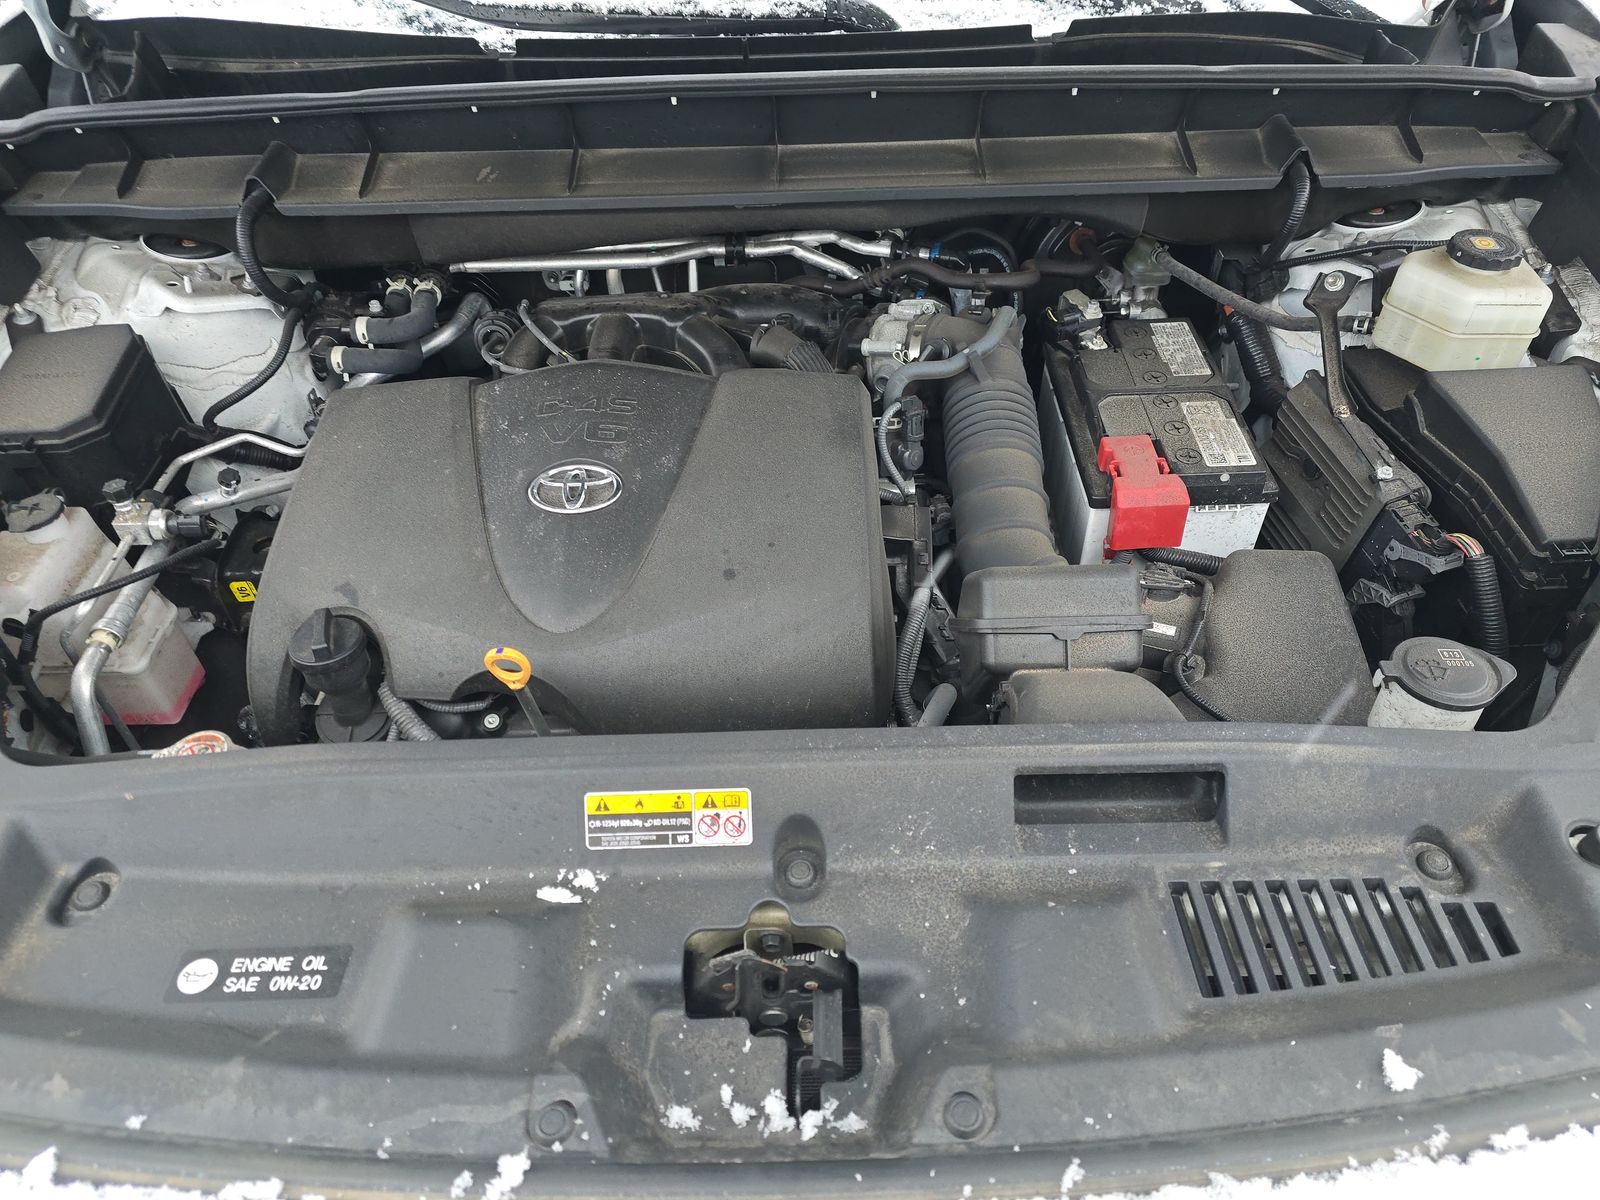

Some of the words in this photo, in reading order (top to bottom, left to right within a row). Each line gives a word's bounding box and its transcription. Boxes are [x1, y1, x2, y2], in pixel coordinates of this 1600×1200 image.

[539, 421, 630, 444] V6
[236, 586, 250, 597] V6
[676, 834, 690, 844] WS
[230, 957, 294, 973] ENGINE
[301, 955, 328, 971] OIL
[222, 976, 261, 993] SAE
[268, 975, 323, 992] 0W-20
